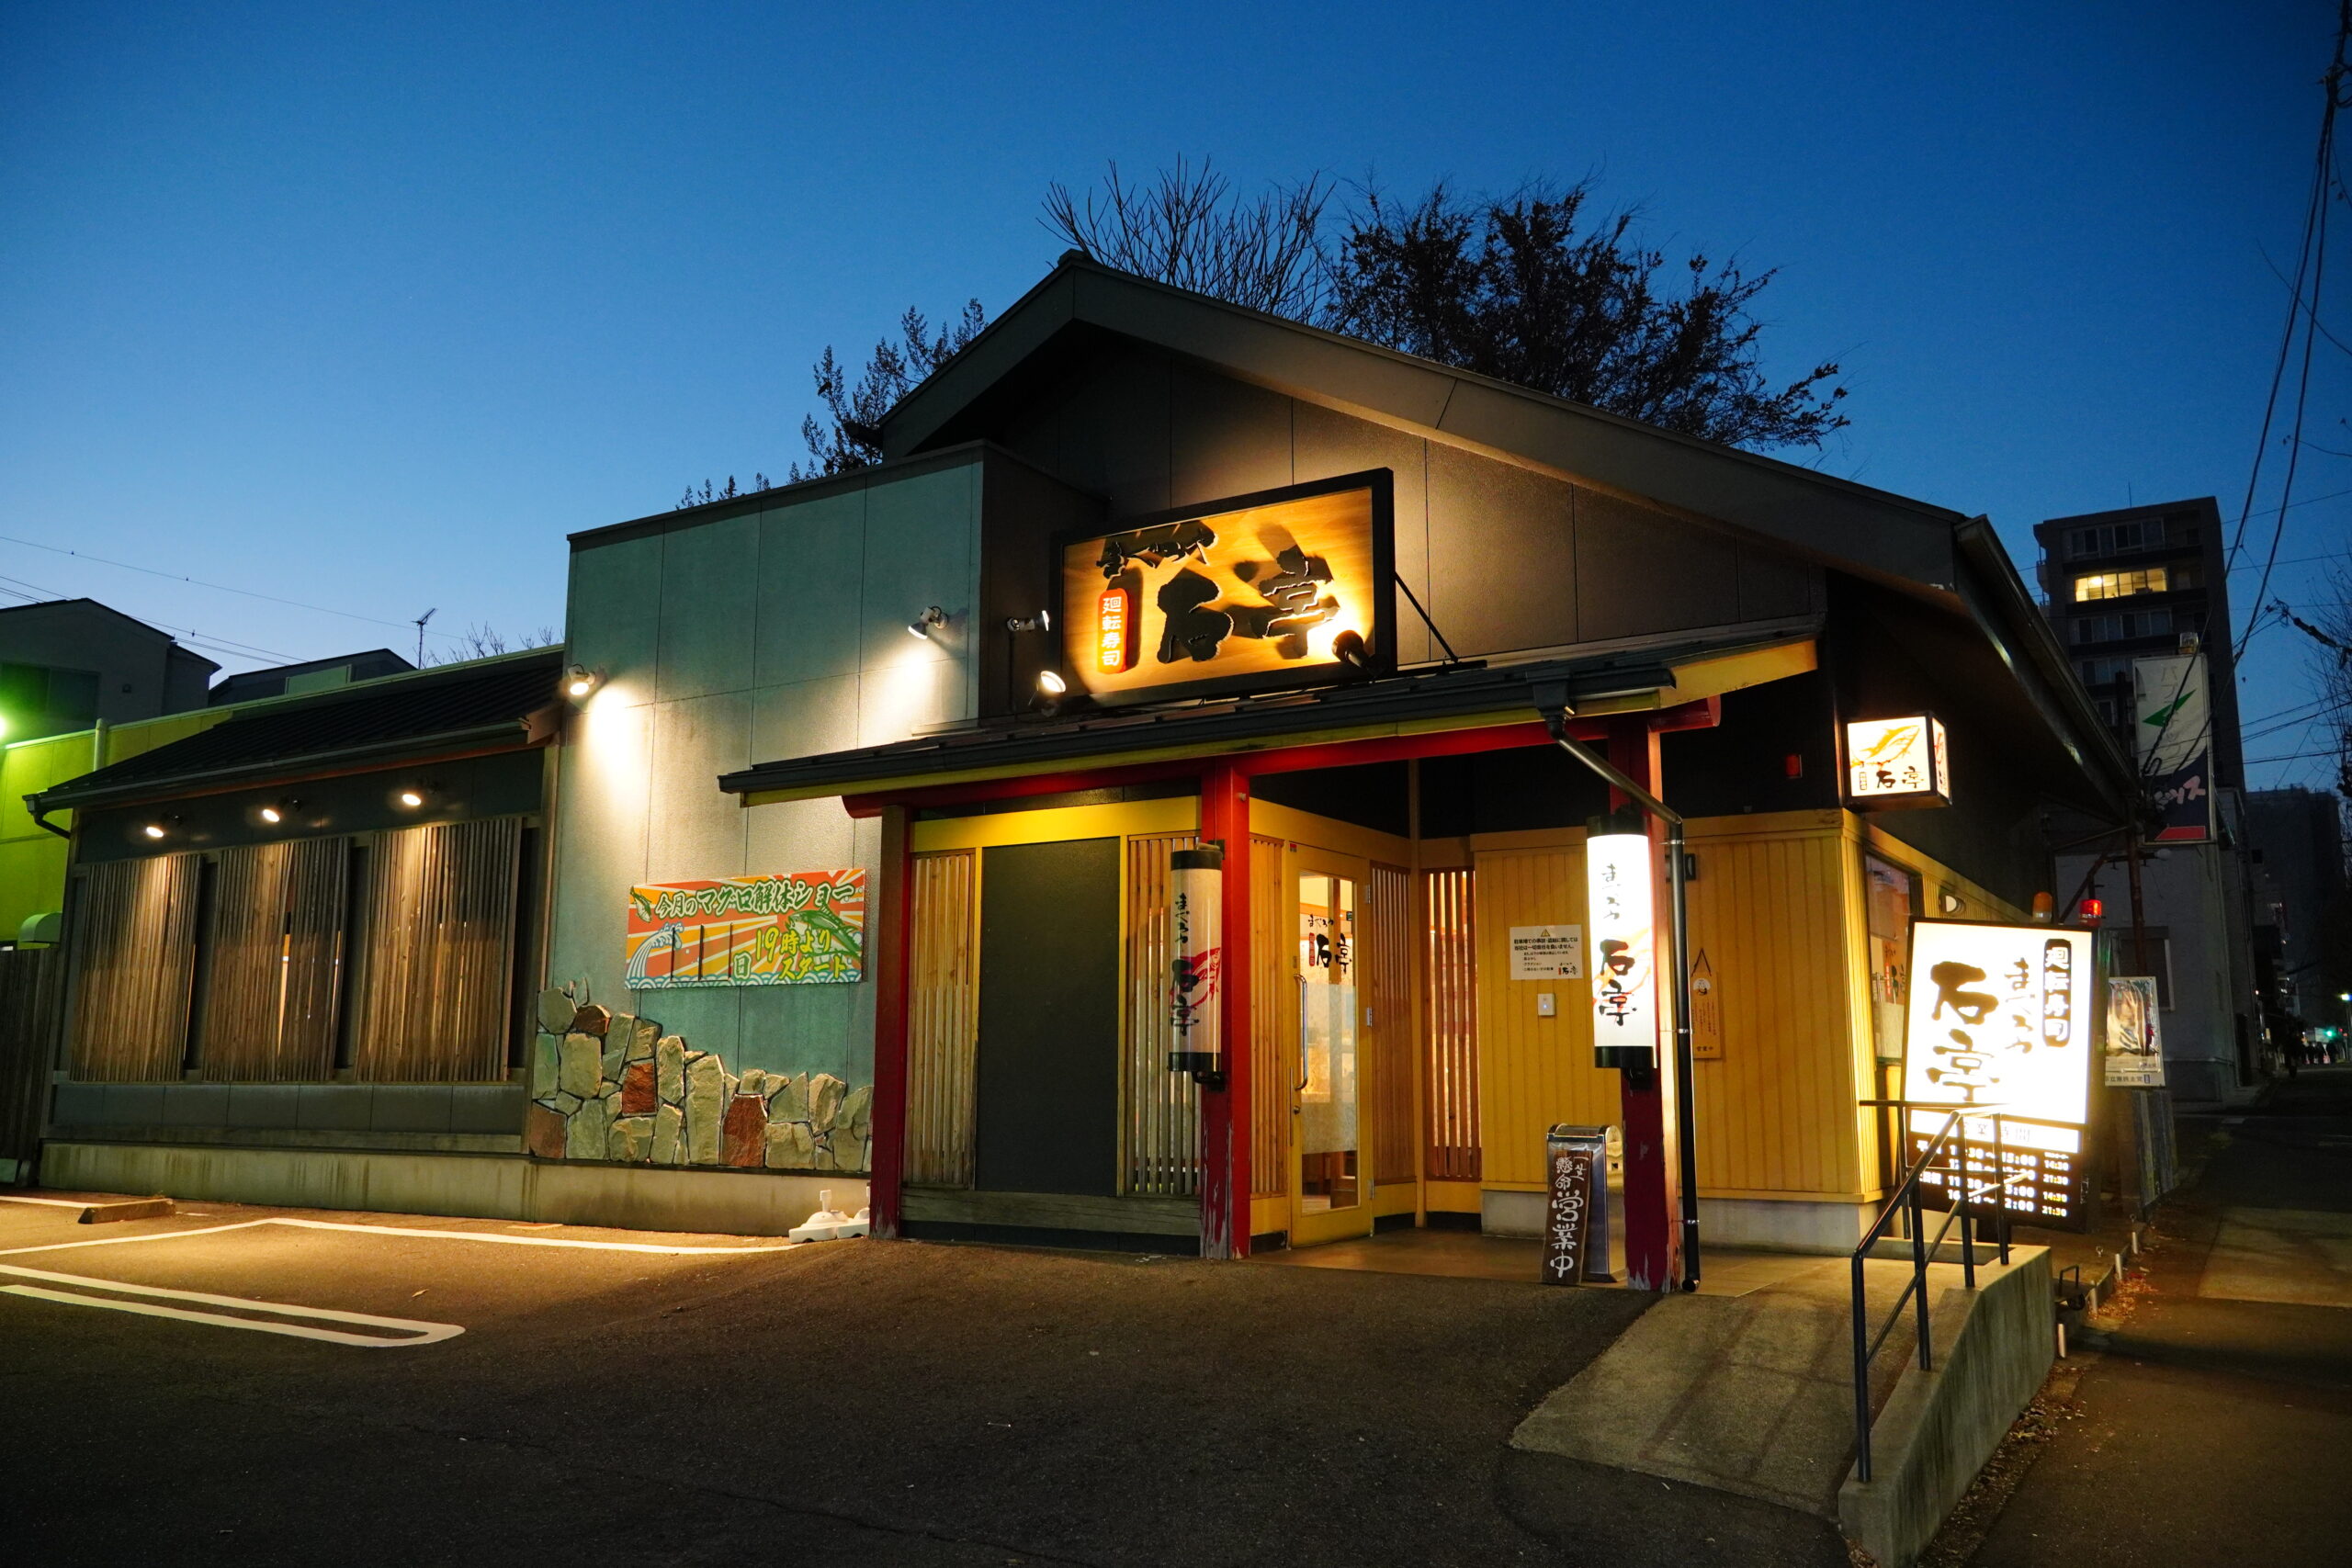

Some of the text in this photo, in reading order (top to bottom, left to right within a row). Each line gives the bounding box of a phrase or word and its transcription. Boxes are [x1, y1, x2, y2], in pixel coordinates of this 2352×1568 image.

[1101, 595, 1123, 668] 廻転寿司
[1876, 765, 1925, 789] 石亭
[655, 877, 856, 919] 今月のマグロ解体ショー
[734, 951, 752, 980] 日
[755, 926, 831, 963] 19時より
[1316, 932, 1352, 974] 石亭
[779, 957, 848, 981] スタート
[1598, 938, 1638, 1027] 石亭
[1170, 958, 1200, 1037] 石亭
[1926, 961, 2000, 1101] 石亭
[1549, 1189, 1584, 1279] 営業中
